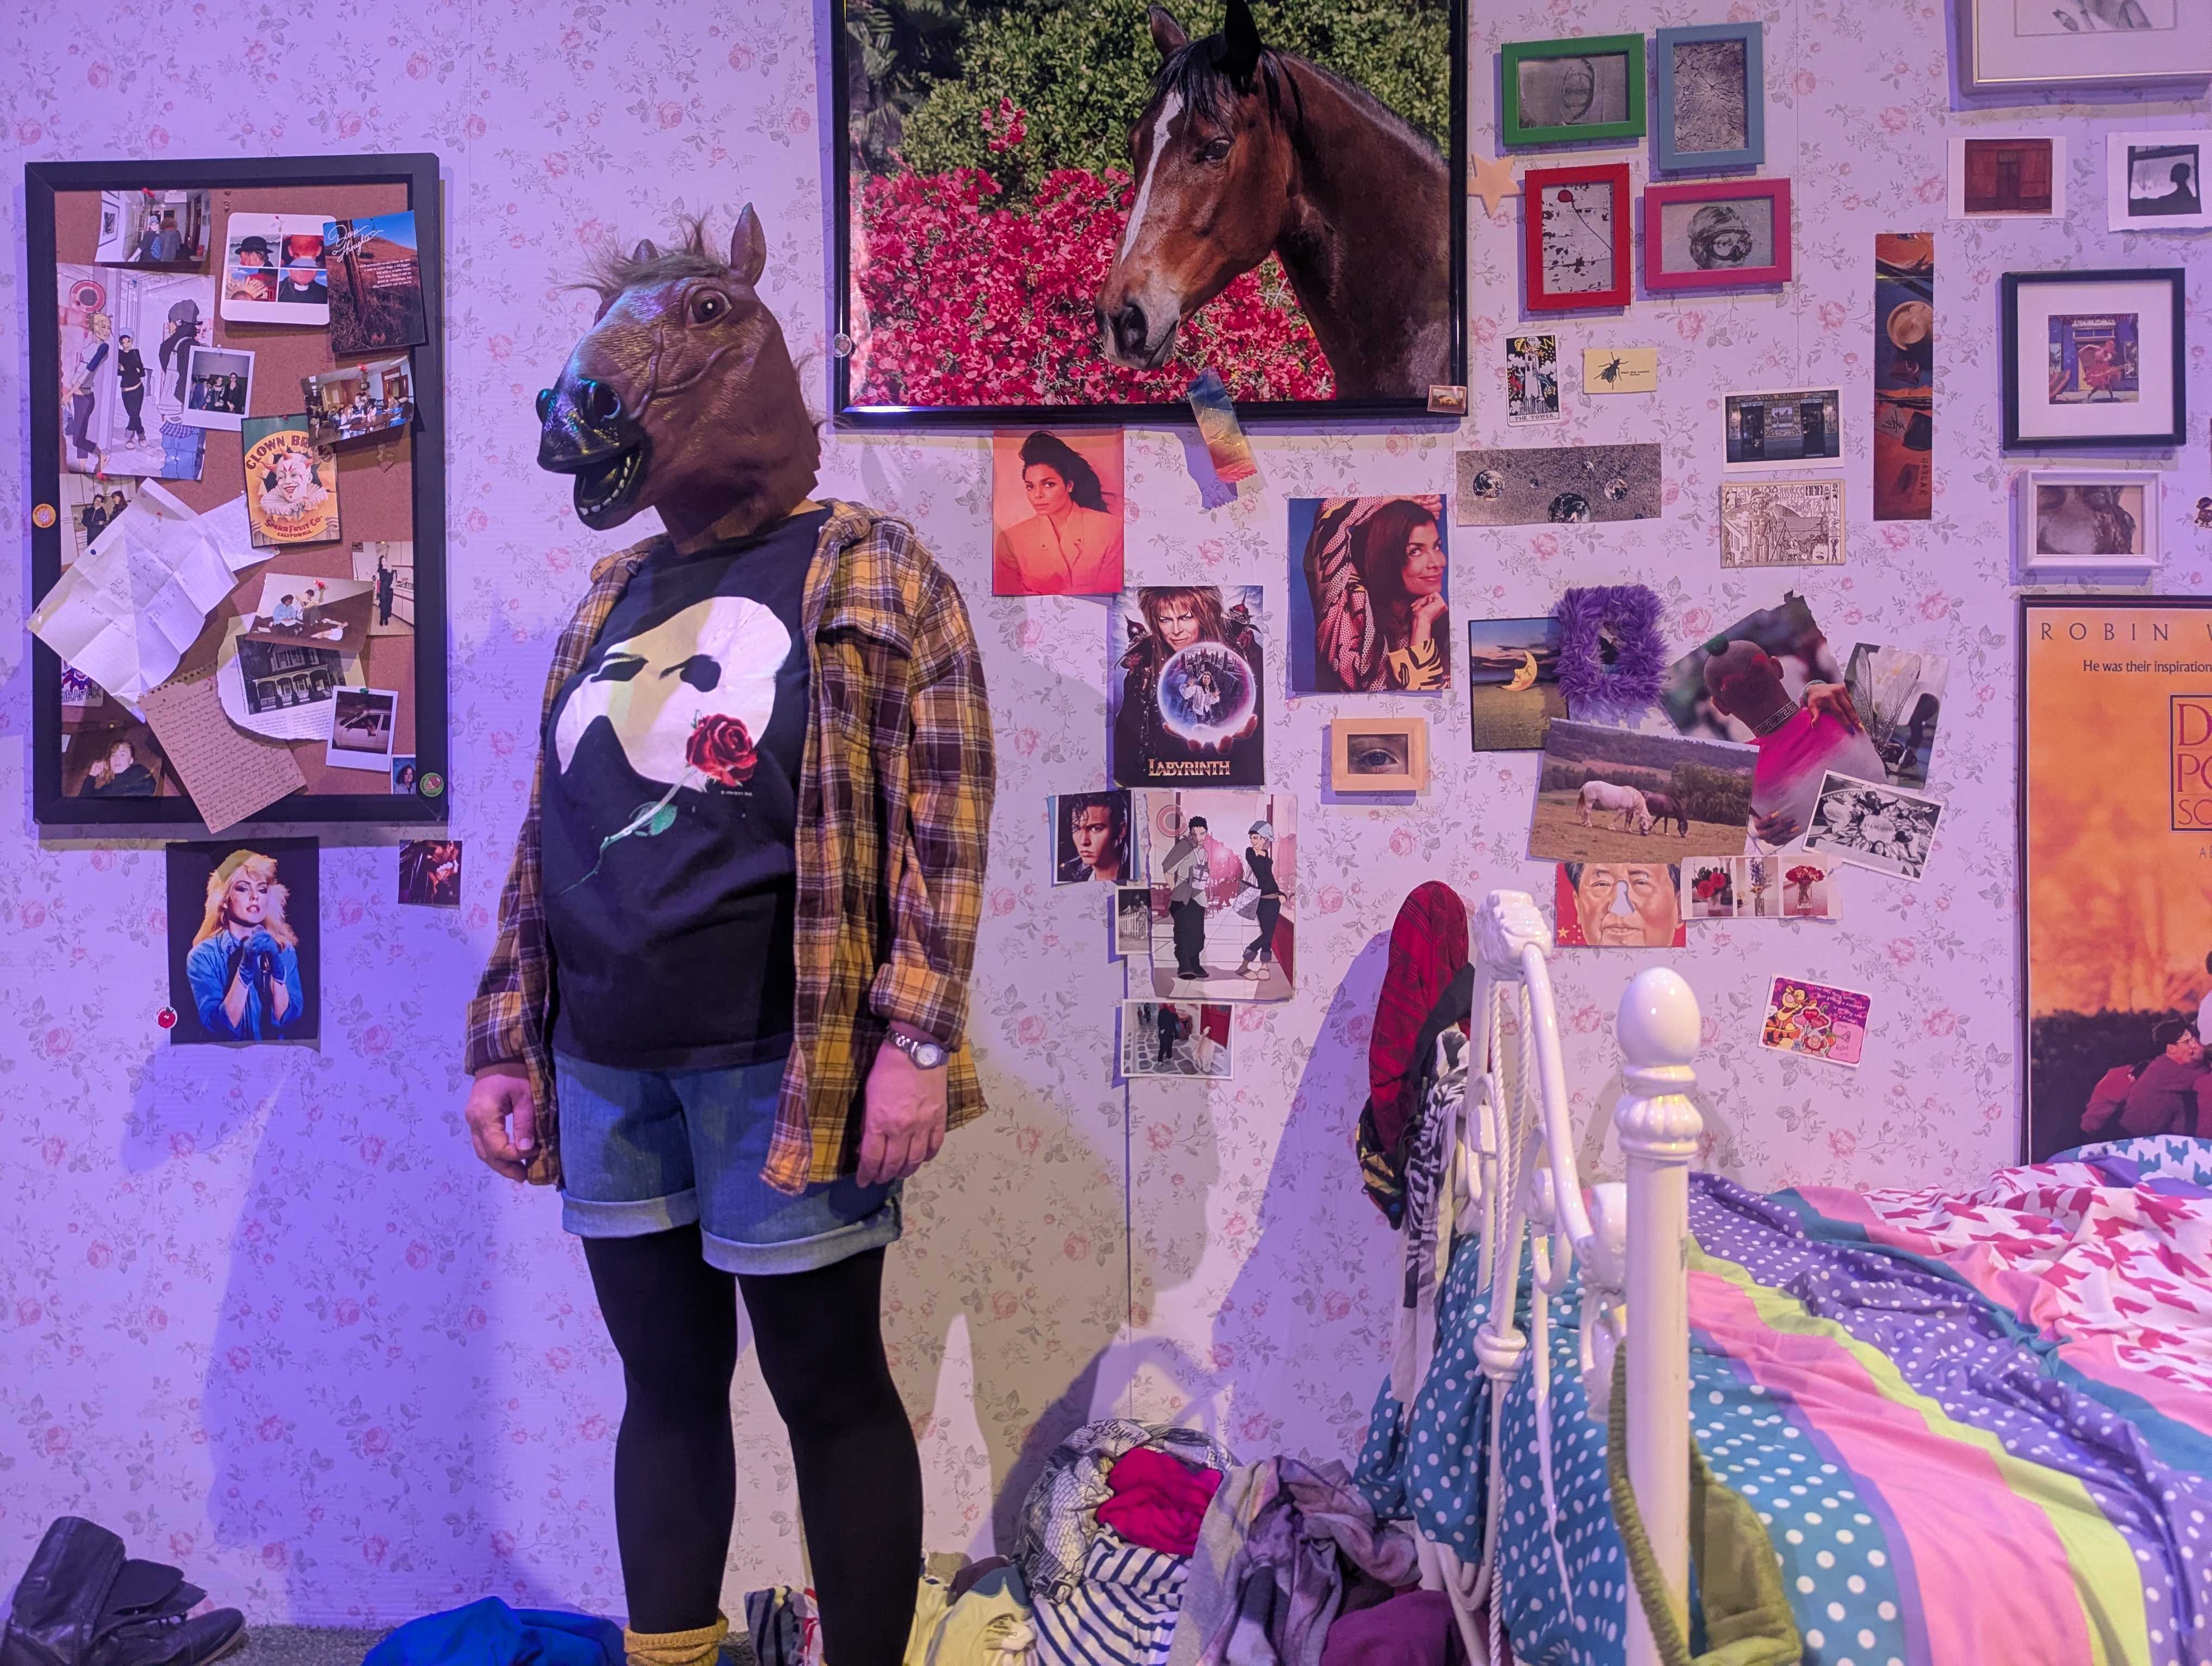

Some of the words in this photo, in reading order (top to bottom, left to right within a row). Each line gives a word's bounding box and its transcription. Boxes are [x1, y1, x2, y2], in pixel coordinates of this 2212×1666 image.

[328, 225, 369, 247] Deep
[246, 435, 286, 470] CLOWN
[291, 434, 333, 463] BRND
[2040, 622, 2169, 641] ROBIN
[2083, 659, 2100, 672] He
[2102, 663, 2123, 672] was
[2125, 660, 2151, 672] their
[1148, 759, 1231, 777] LABYRINTH
